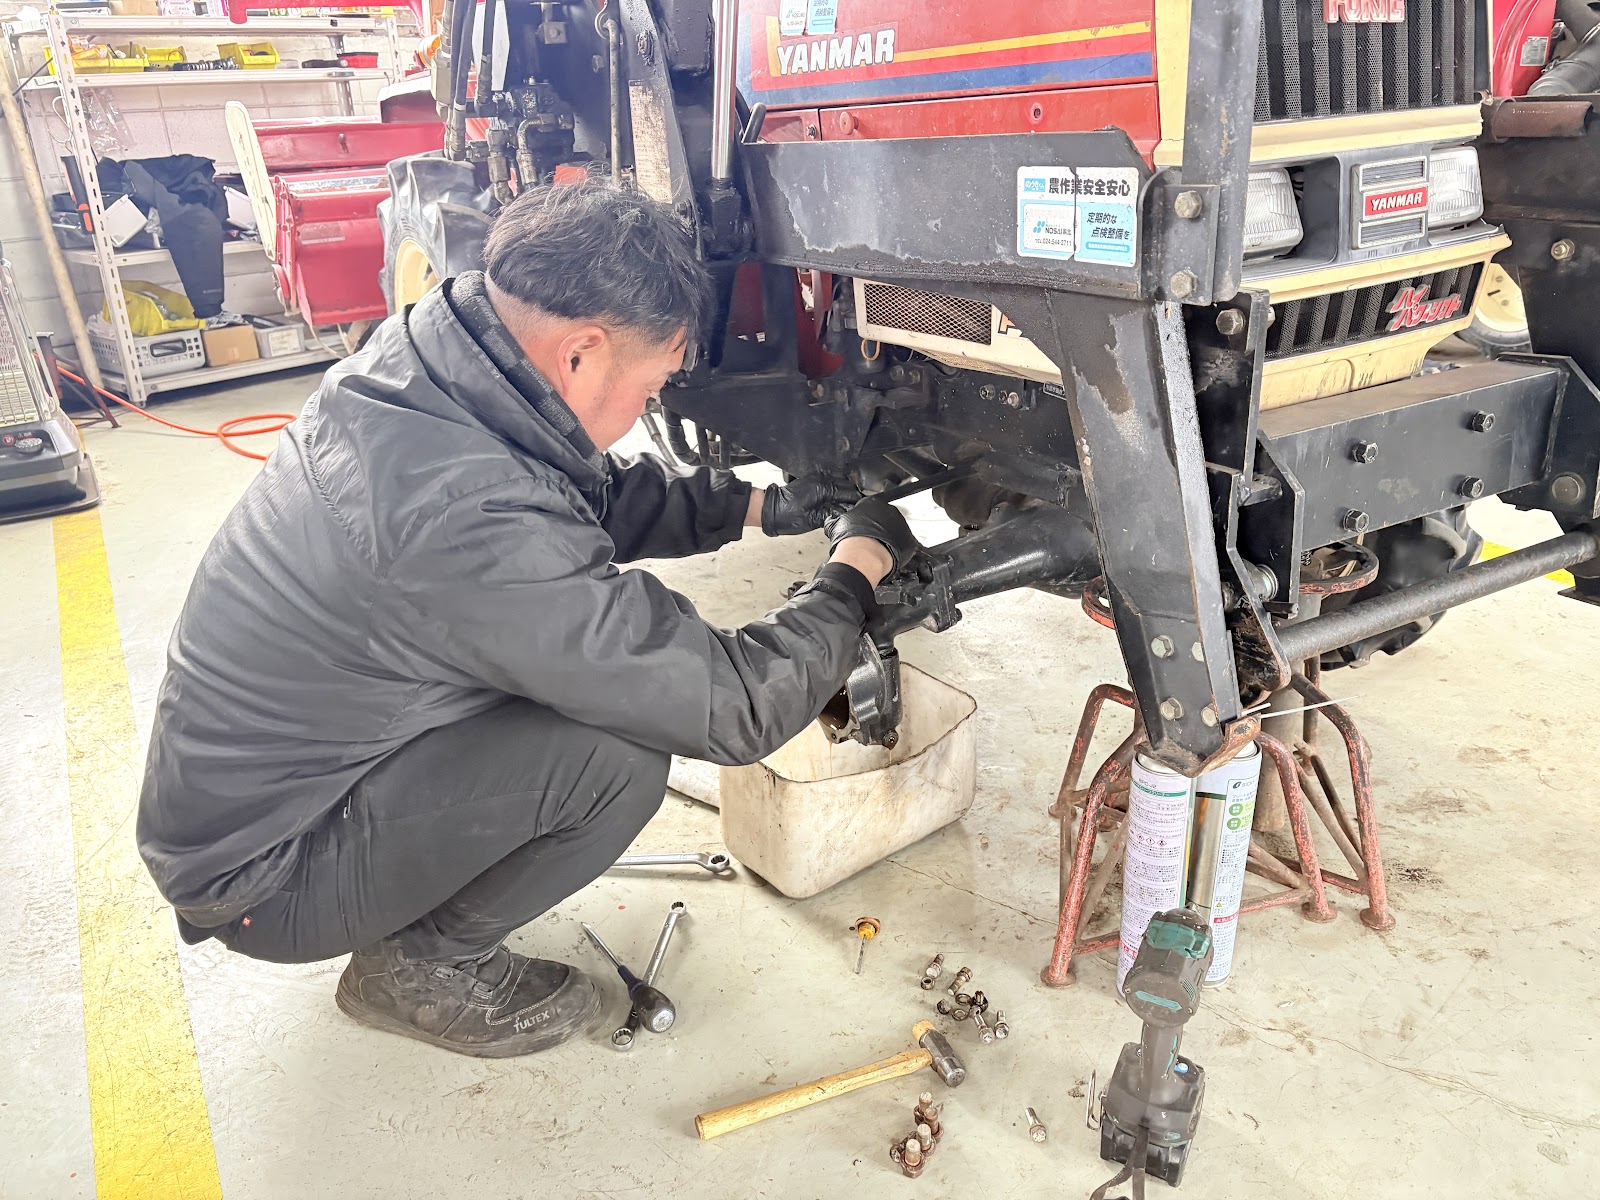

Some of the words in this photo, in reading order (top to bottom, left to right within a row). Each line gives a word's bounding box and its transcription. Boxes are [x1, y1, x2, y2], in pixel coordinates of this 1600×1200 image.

[777, 28, 896, 76] YANMAR
[1049, 177, 1131, 197] 農作業安全安心
[1371, 191, 1424, 211] YANMAR
[1087, 212, 1118, 225] 定期的な
[1091, 226, 1130, 240] 点検整備を
[513, 1010, 550, 1033] TULTEX
